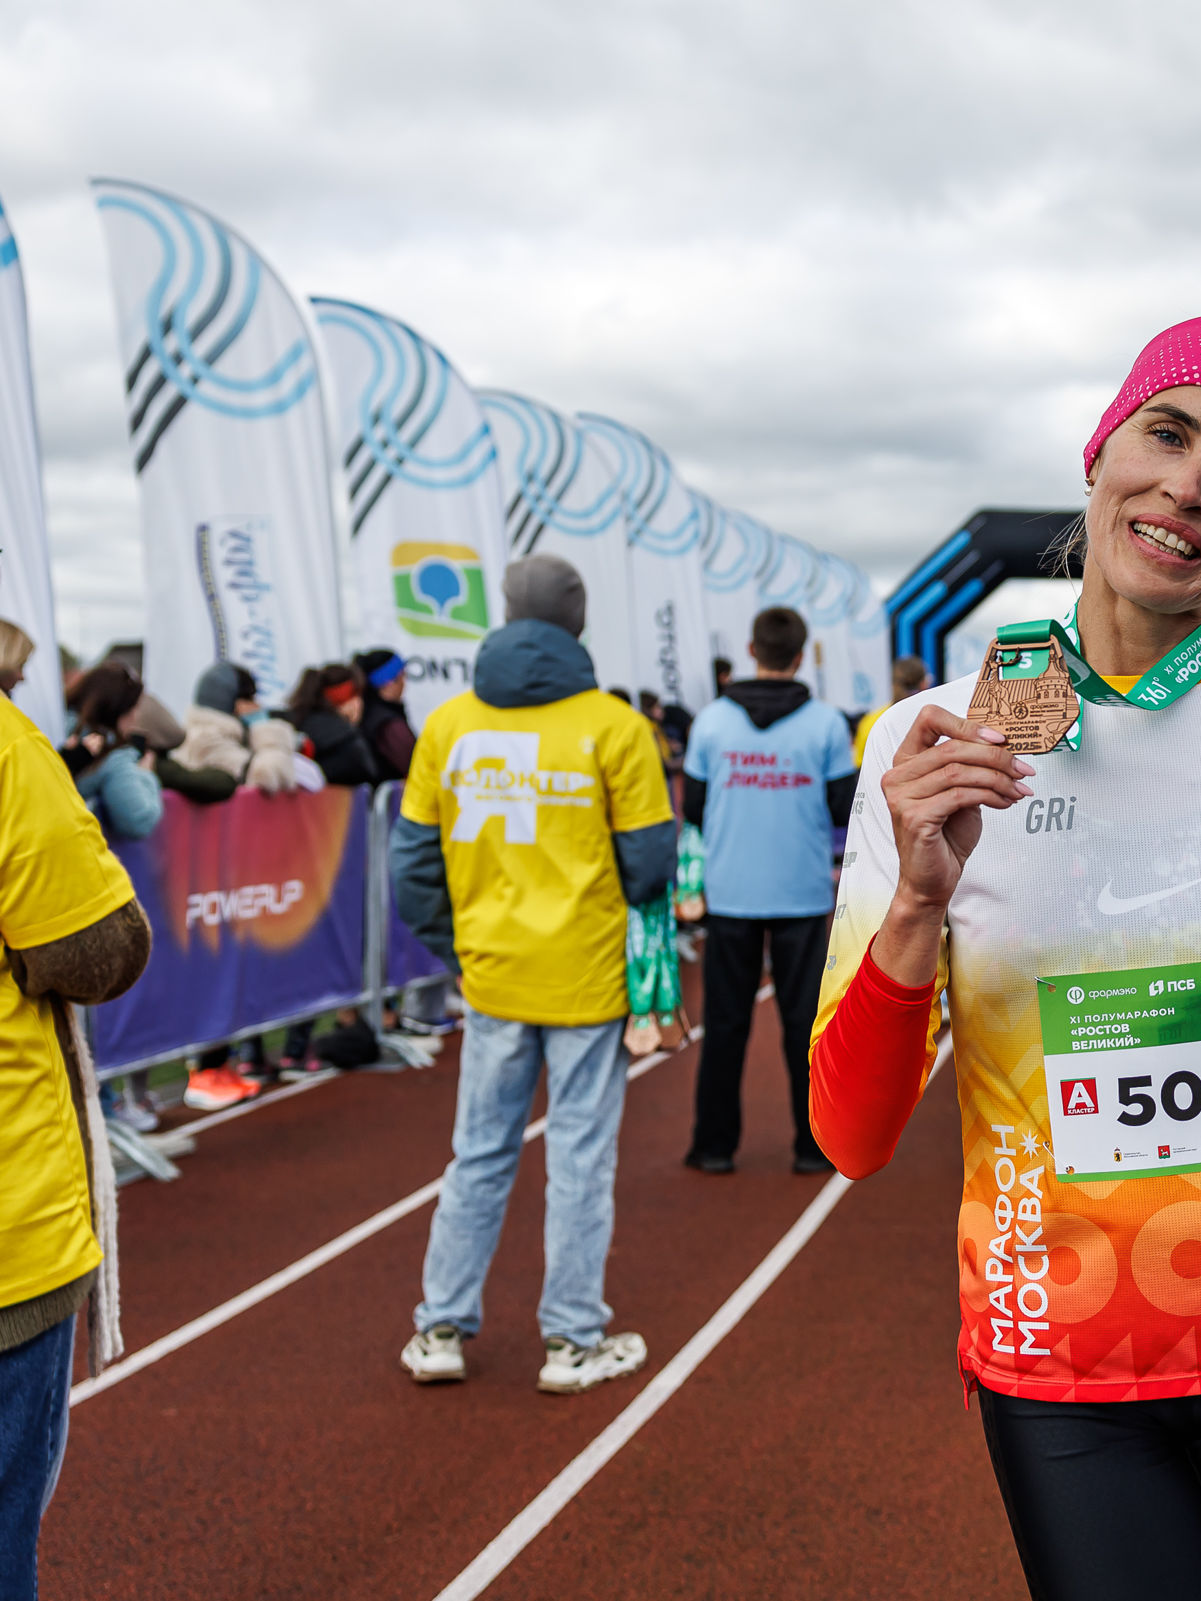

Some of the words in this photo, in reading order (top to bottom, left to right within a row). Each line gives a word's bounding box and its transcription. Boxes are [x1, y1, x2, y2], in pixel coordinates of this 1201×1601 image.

[1006, 741, 1040, 752] 2025
[1088, 986, 1138, 1000] фармэко
[1167, 978, 1196, 993] ПСБ
[1084, 1006, 1175, 1023] ПОЛУМАРАФОН
[1070, 1023, 1130, 1037] «РОСТОВ
[1071, 1034, 1141, 1051] ВЕЛИКИЙ»
[1067, 1107, 1096, 1115] КЛАСТЕР
[985, 1124, 1017, 1354] МАРАФОН
[1015, 1164, 1051, 1356] МОСКВА
